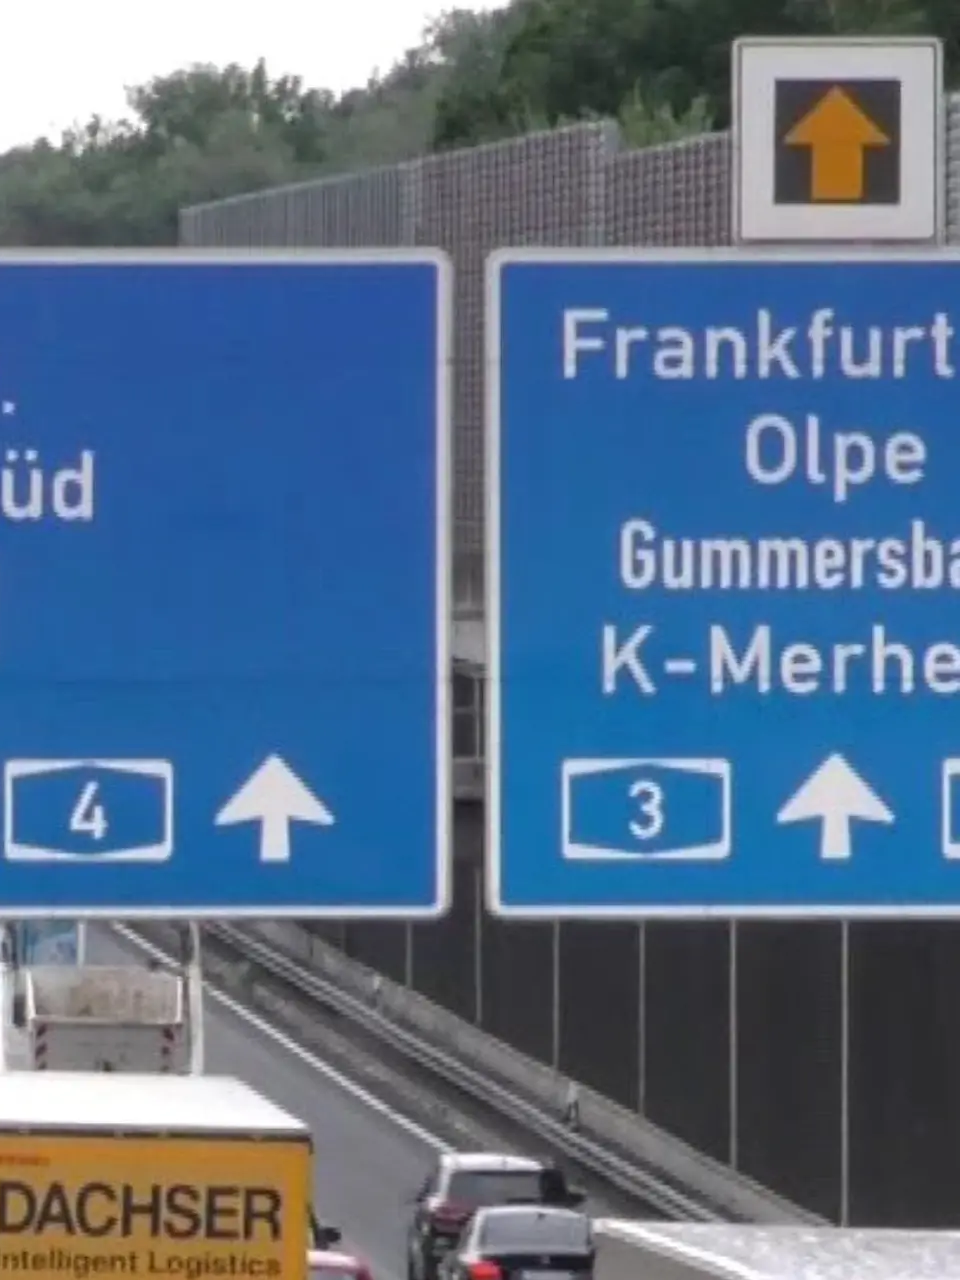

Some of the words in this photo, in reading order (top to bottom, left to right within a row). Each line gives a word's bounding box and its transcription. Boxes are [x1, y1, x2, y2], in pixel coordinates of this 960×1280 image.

[563, 308, 954, 379] Frankfurt
[745, 413, 926, 503] Olpe
[70, 781, 108, 840] 4
[629, 779, 664, 840] 3
[148, 1251, 282, 1280] Logistics
